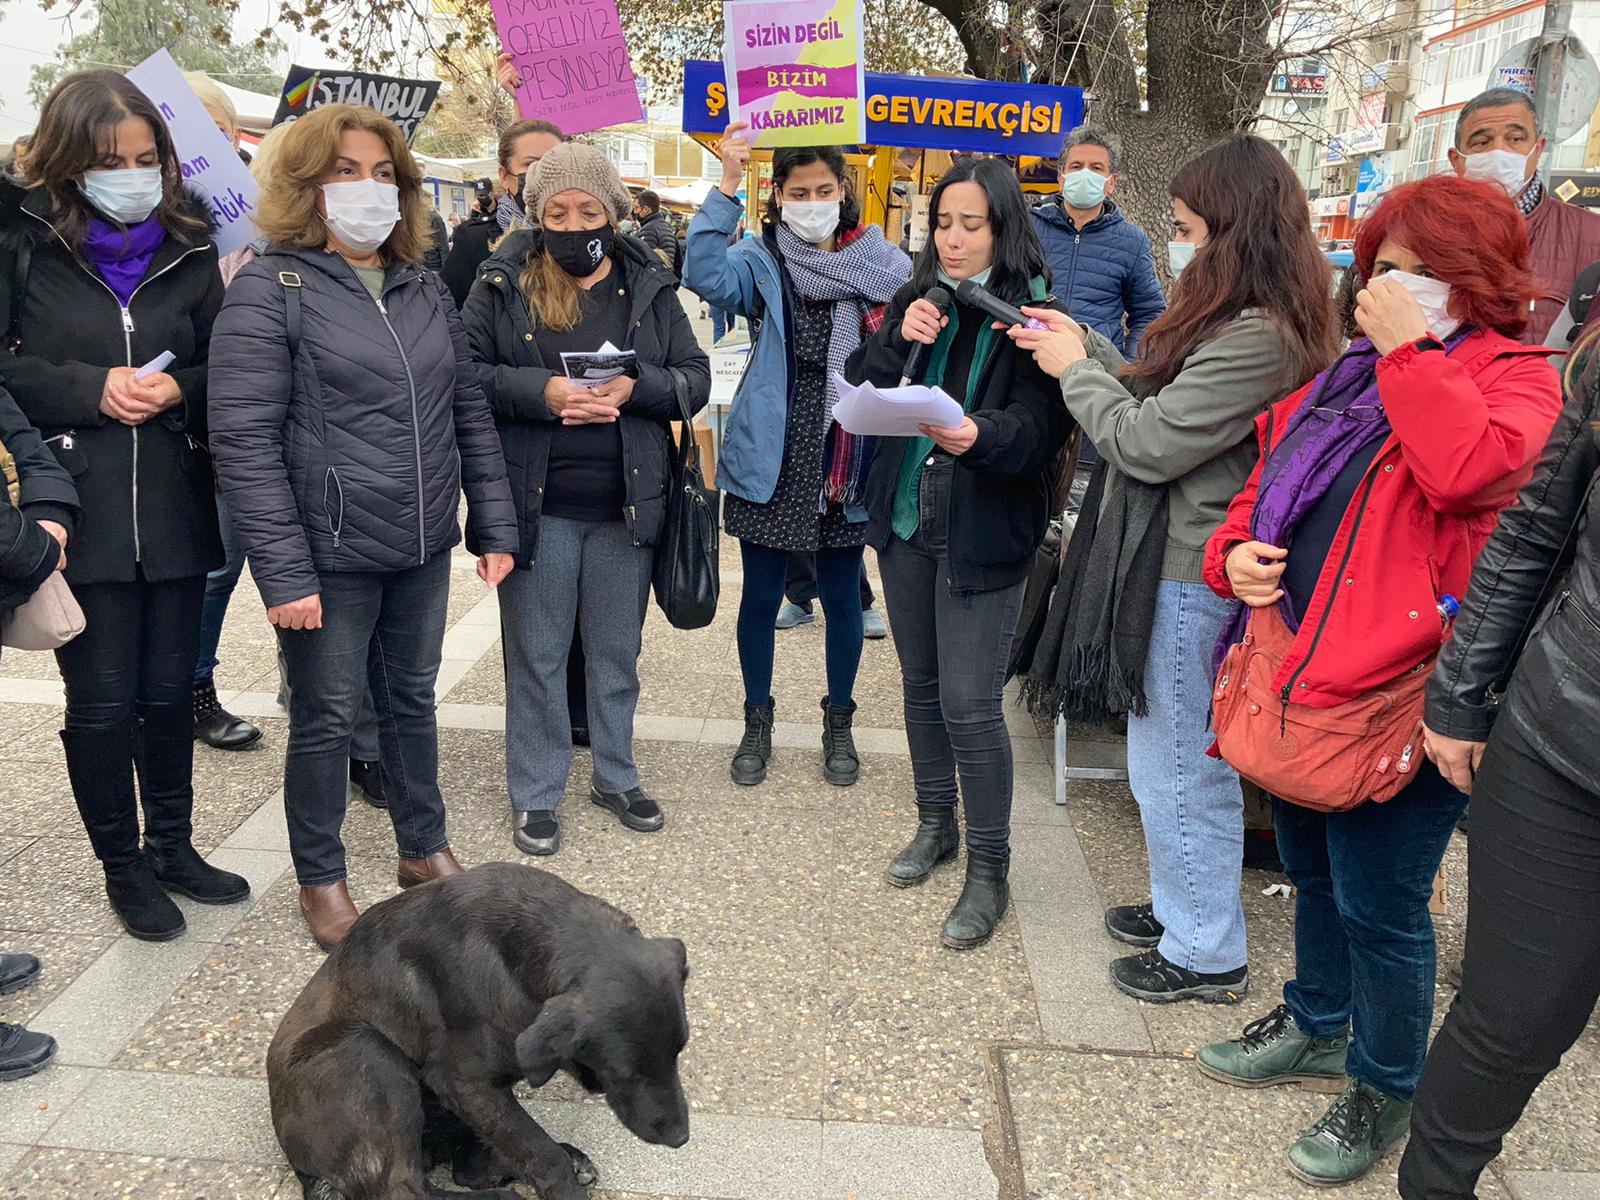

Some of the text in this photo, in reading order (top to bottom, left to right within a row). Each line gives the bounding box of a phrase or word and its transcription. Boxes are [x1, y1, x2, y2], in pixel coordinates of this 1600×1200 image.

[745, 22, 791, 48] SİZİN
[521, 46, 634, 101] PEŞİNDEYİZ
[767, 69, 827, 87] BİZİM
[305, 71, 427, 118] İSTANBUL
[750, 105, 845, 130] KARARIMIZ
[866, 94, 1062, 137] GEVREKÇİSİ
